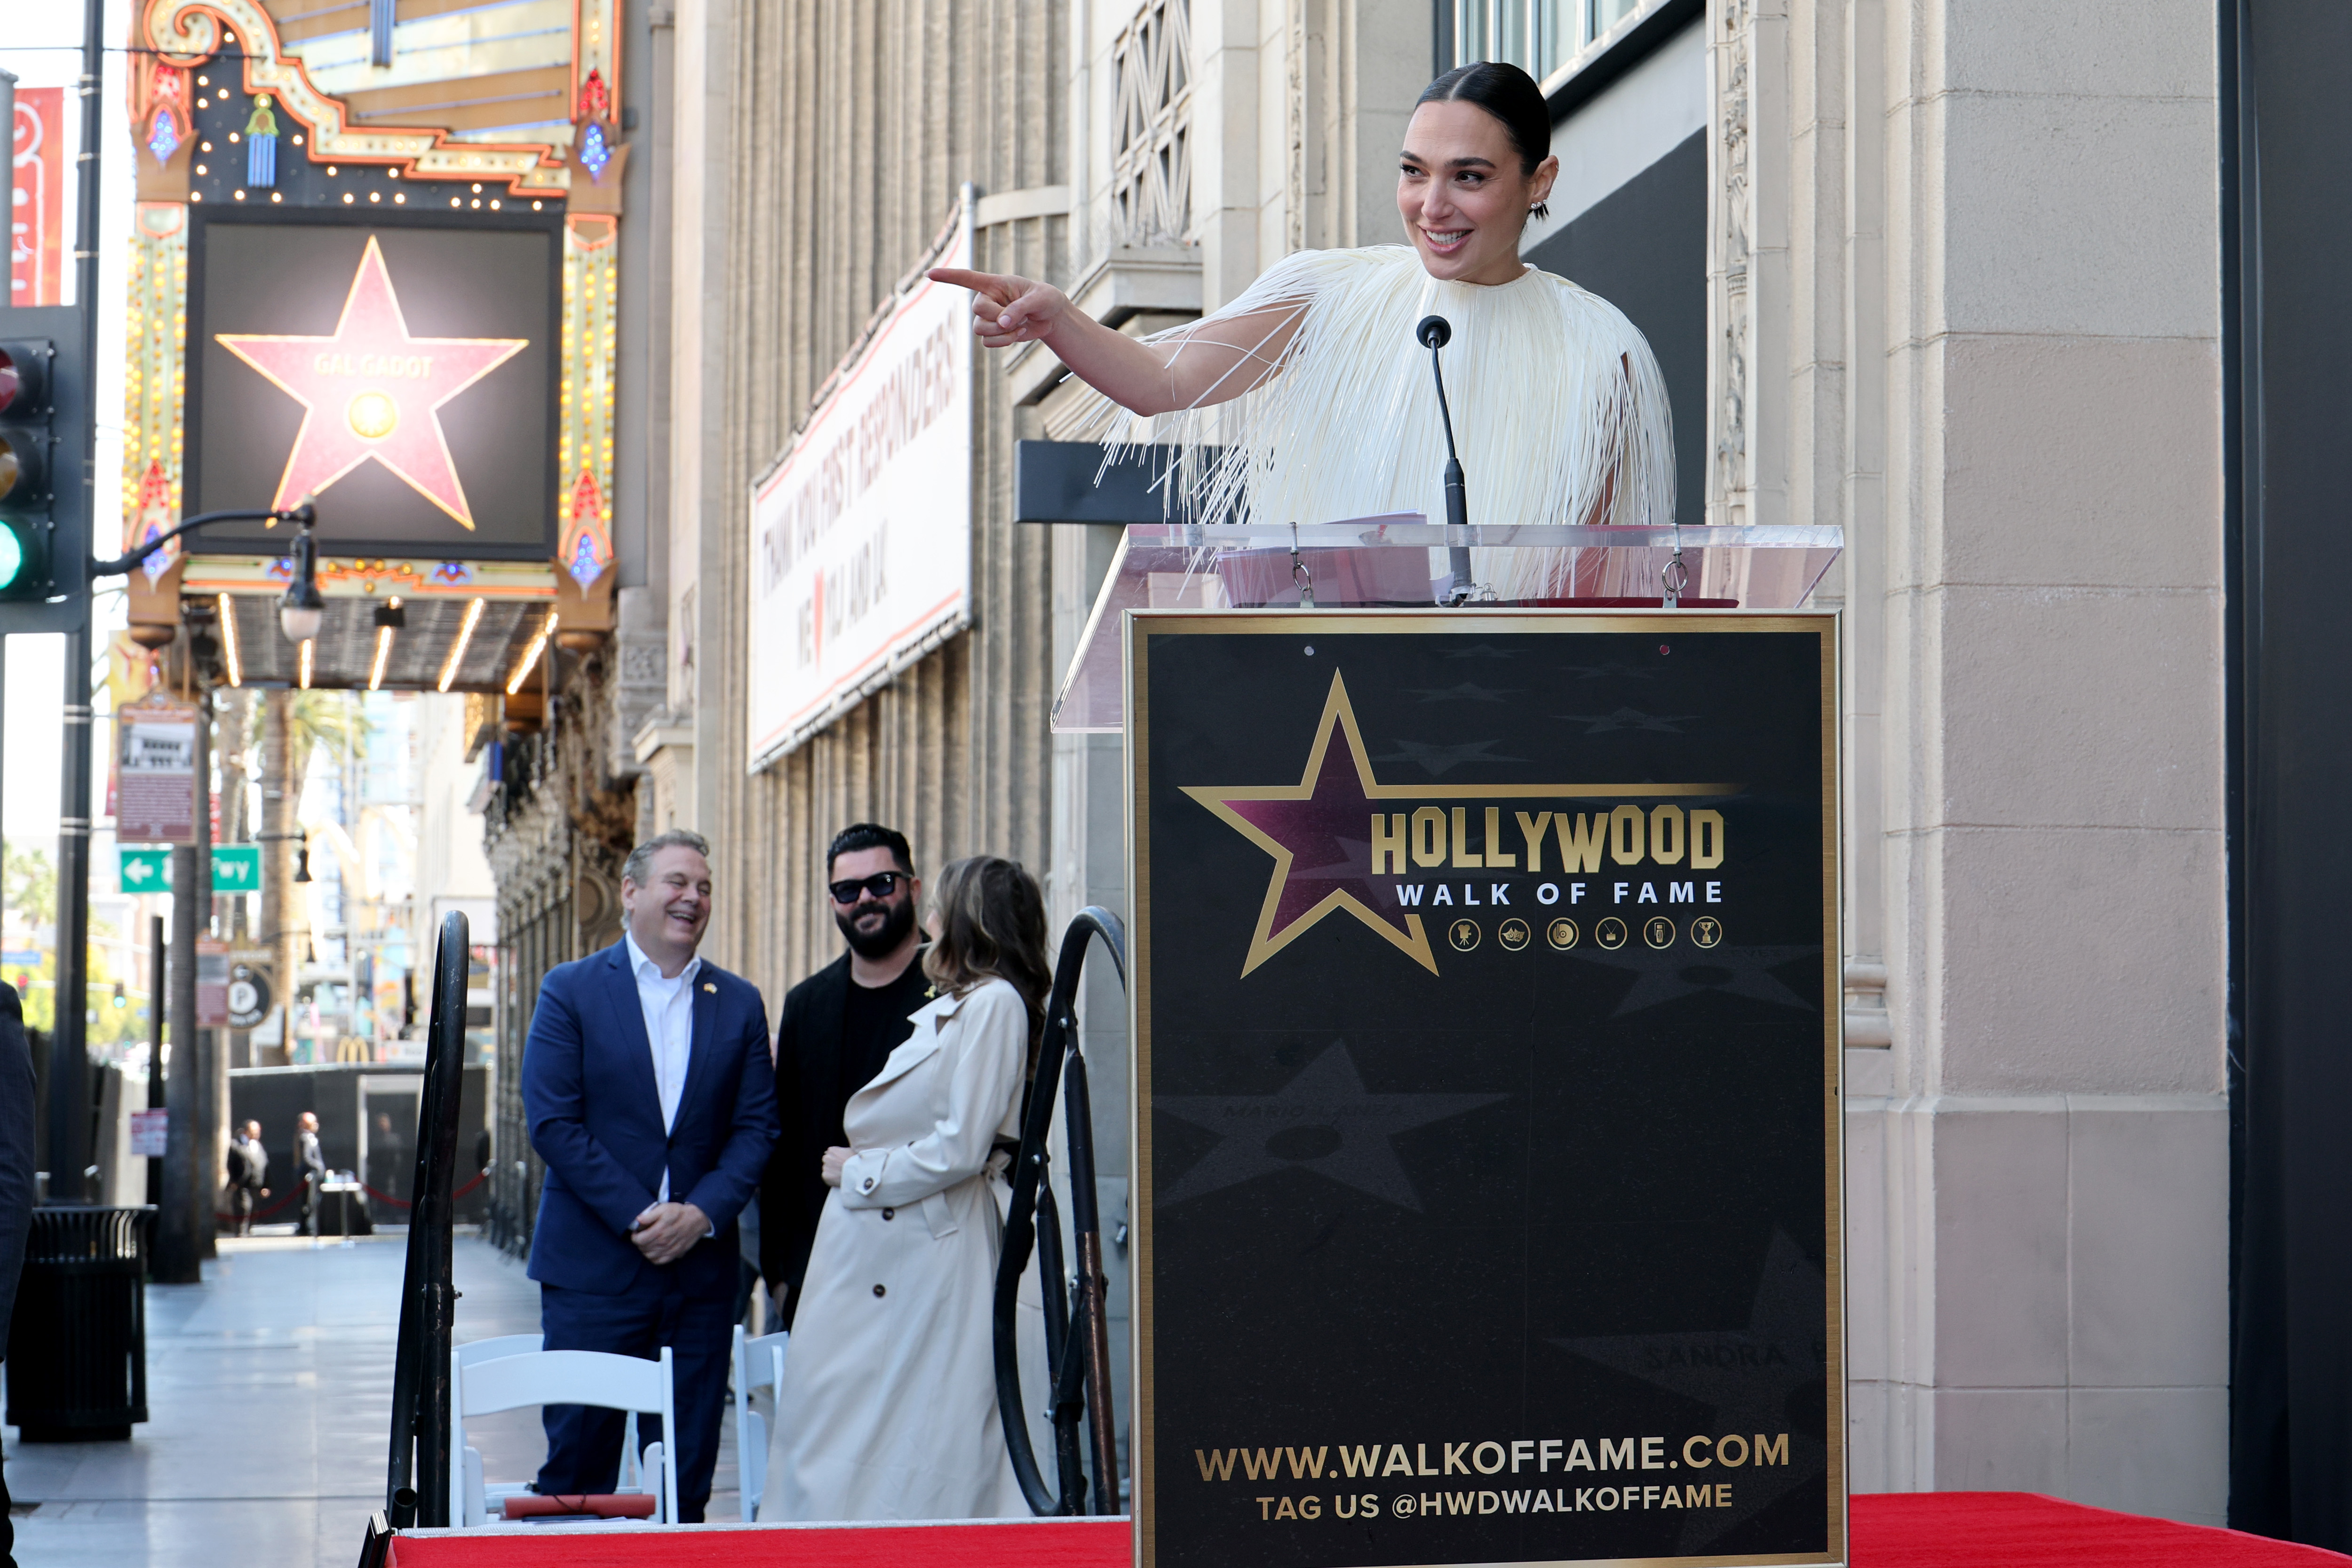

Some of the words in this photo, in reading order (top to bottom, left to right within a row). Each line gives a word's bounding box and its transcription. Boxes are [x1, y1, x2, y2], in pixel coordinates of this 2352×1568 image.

[314, 353, 356, 377] GAL
[359, 353, 434, 380] GADOT
[797, 470, 819, 563] YOU
[820, 424, 854, 537] FIRST
[848, 540, 870, 629] AND
[1371, 804, 1724, 875] HOLLYWOOD
[1396, 883, 1510, 907] WALK
[1536, 883, 1586, 905] OF
[1614, 881, 1722, 904] FAME
[1645, 1343, 1789, 1369] SANDRA
[1195, 1433, 1789, 1481] WWW.WALKOFFAME.COM
[1256, 1496, 1321, 1520] TAG
[1335, 1494, 1380, 1519] US
[1392, 1483, 1732, 1520] @HWDWALKOFFAME
